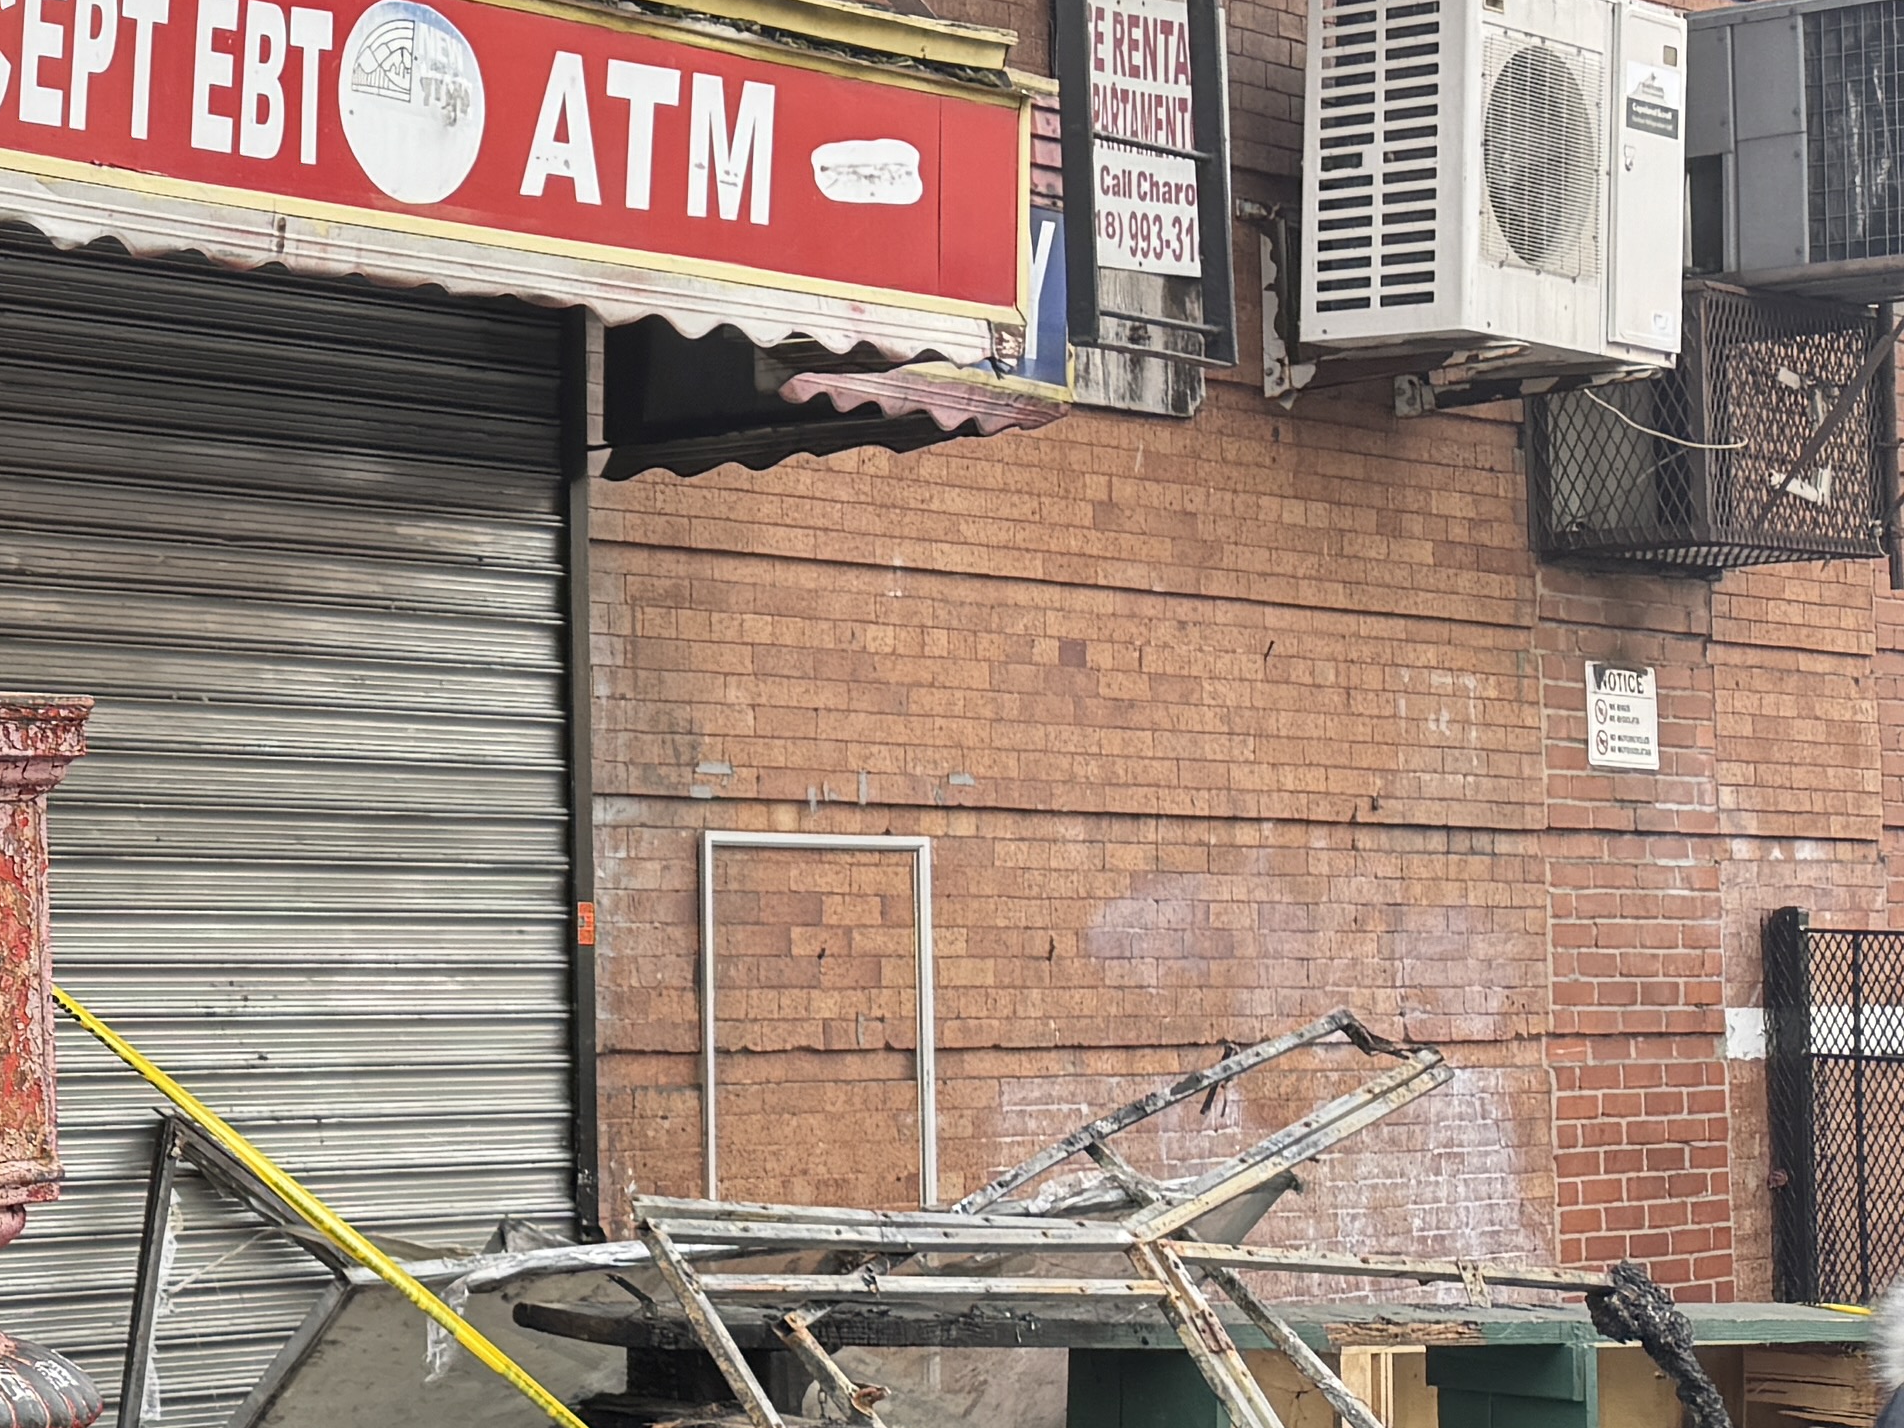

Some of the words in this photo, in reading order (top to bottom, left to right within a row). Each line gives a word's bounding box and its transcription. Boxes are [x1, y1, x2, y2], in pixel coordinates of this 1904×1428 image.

[519, 49, 776, 226] ATM
[1093, 81, 1195, 158] PARTAMENT
[1100, 164, 1133, 201] Call
[1136, 170, 1196, 208] Charo
[1128, 210, 1196, 264] 993-31
